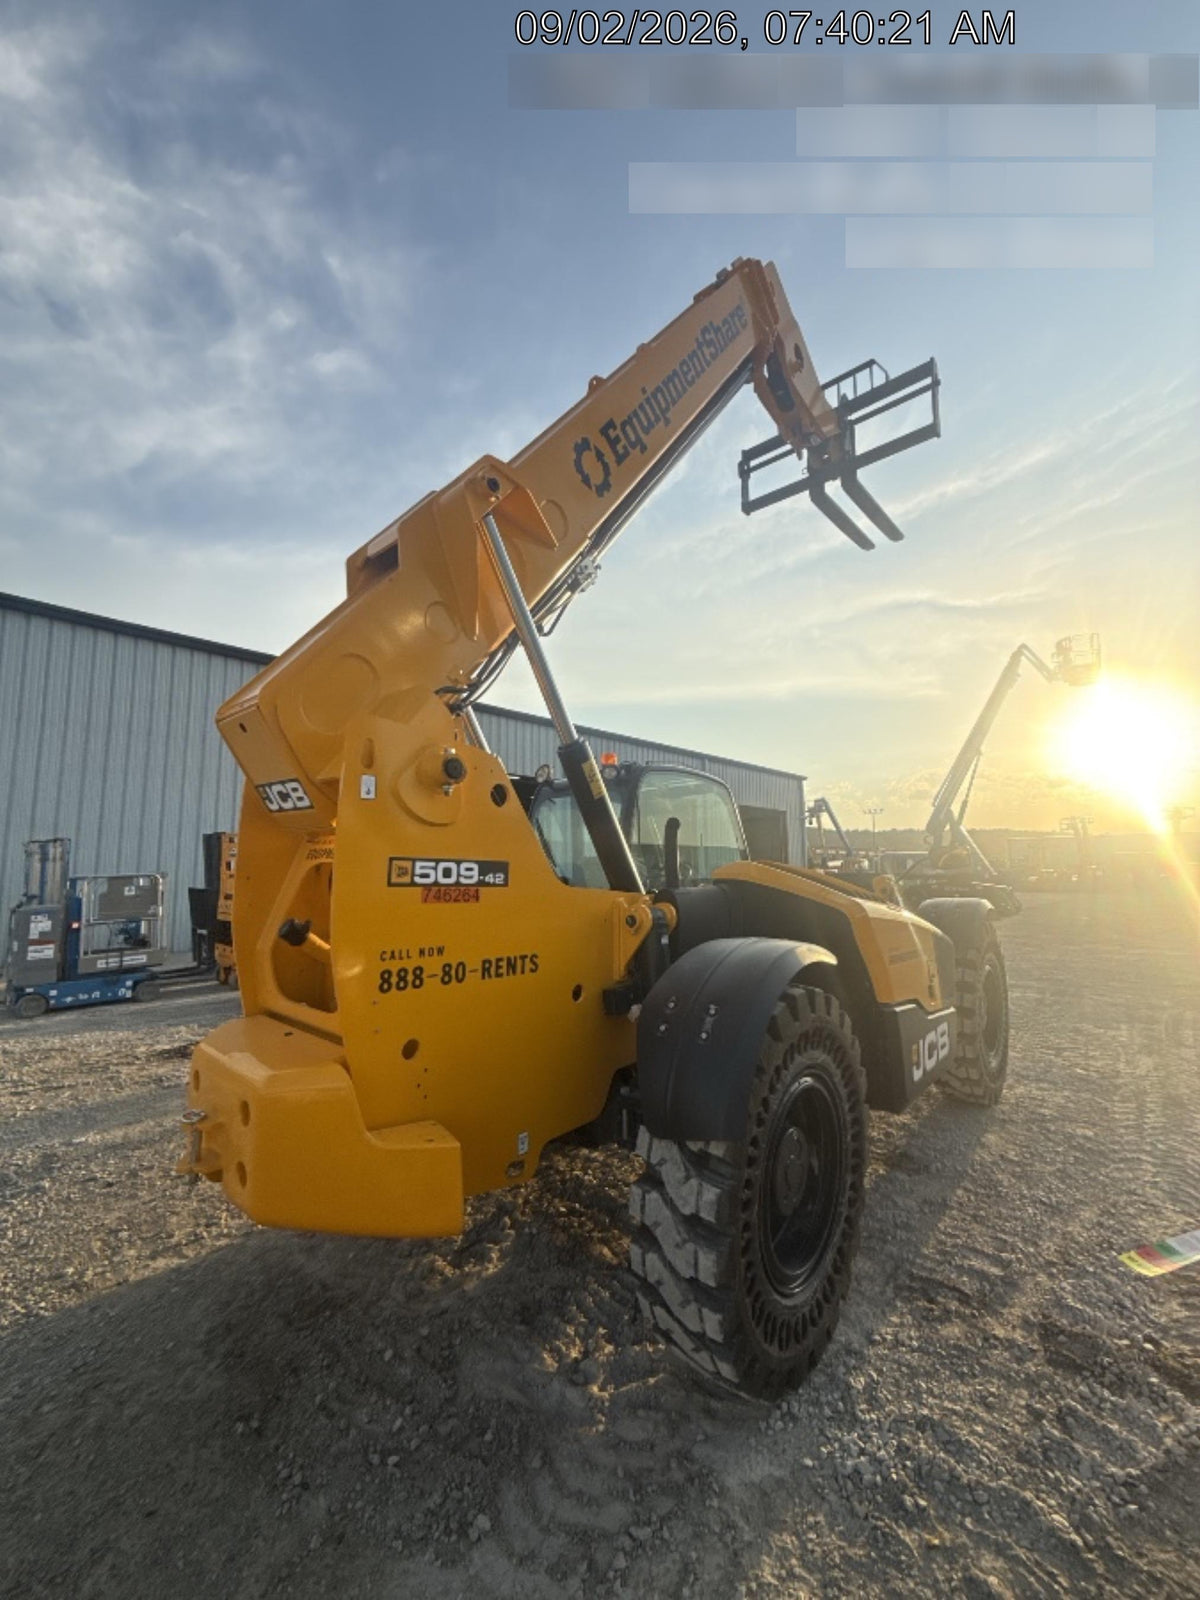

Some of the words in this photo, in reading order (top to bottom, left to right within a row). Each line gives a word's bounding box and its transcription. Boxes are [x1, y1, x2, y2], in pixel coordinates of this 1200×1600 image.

[599, 305, 749, 468] EquipmentShare
[259, 780, 312, 811] JCB
[422, 886, 481, 904] 746264
[379, 949, 413, 962] CALL
[418, 946, 446, 959] NOW
[378, 953, 540, 994] 888-80-RENTS
[911, 1021, 950, 1082] JCB
